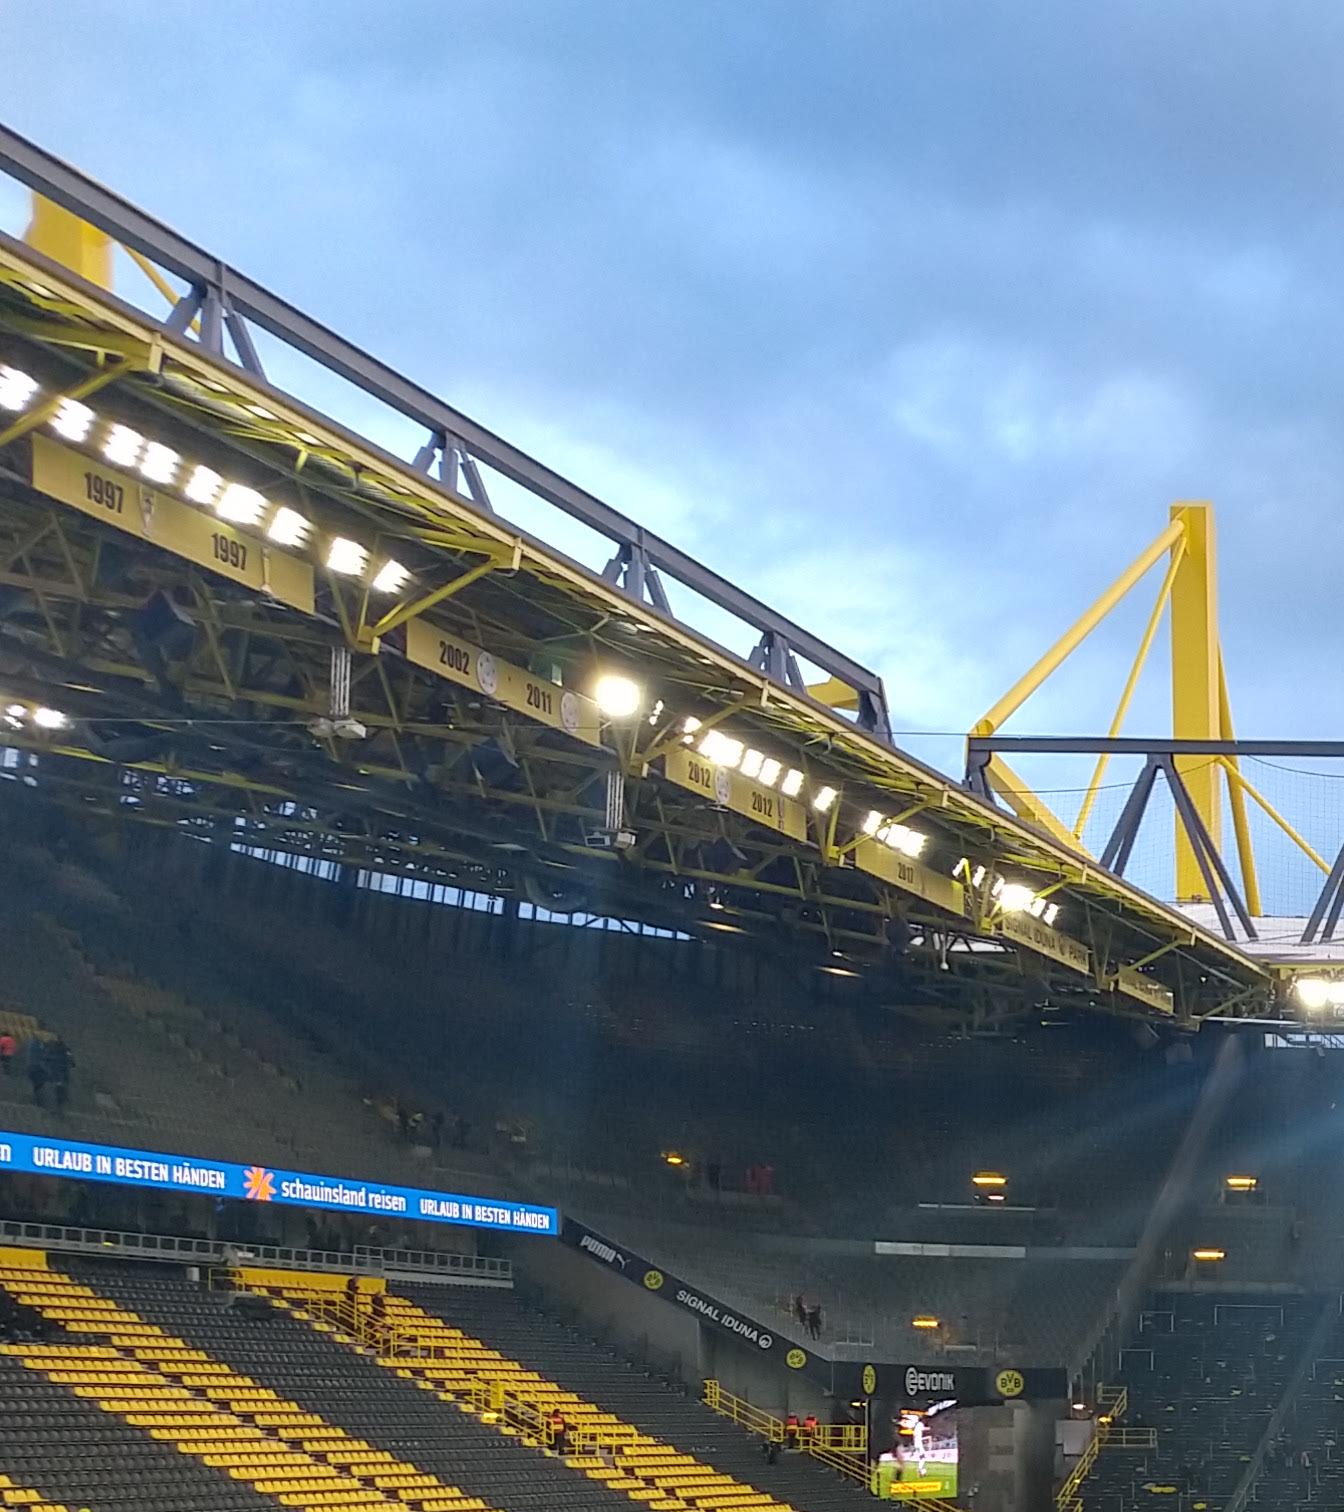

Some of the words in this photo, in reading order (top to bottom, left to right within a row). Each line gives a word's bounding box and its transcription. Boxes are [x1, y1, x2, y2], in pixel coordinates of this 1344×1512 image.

[84, 472, 124, 513] 1997
[211, 532, 248, 570] 1997
[439, 640, 470, 676] 2002
[526, 683, 553, 715] 2011
[688, 760, 711, 789] 2012
[752, 791, 773, 817] 2012
[897, 861, 914, 884] 2017
[33, 1146, 92, 1172] URLAUB
[96, 1154, 111, 1174] IN
[115, 1158, 169, 1182] BESTEN
[173, 1162, 225, 1189] HÄNDEN
[281, 1178, 367, 1207] schauinsland
[368, 1189, 406, 1212] reisen
[420, 1198, 459, 1218] URLAUB
[461, 1203, 473, 1220] IN
[475, 1205, 511, 1225] BESTEN
[513, 1208, 550, 1230] HÄNDEN
[580, 1235, 616, 1263] PUMA
[676, 1289, 719, 1322] SIGNAL
[721, 1314, 758, 1343] IDUNA
